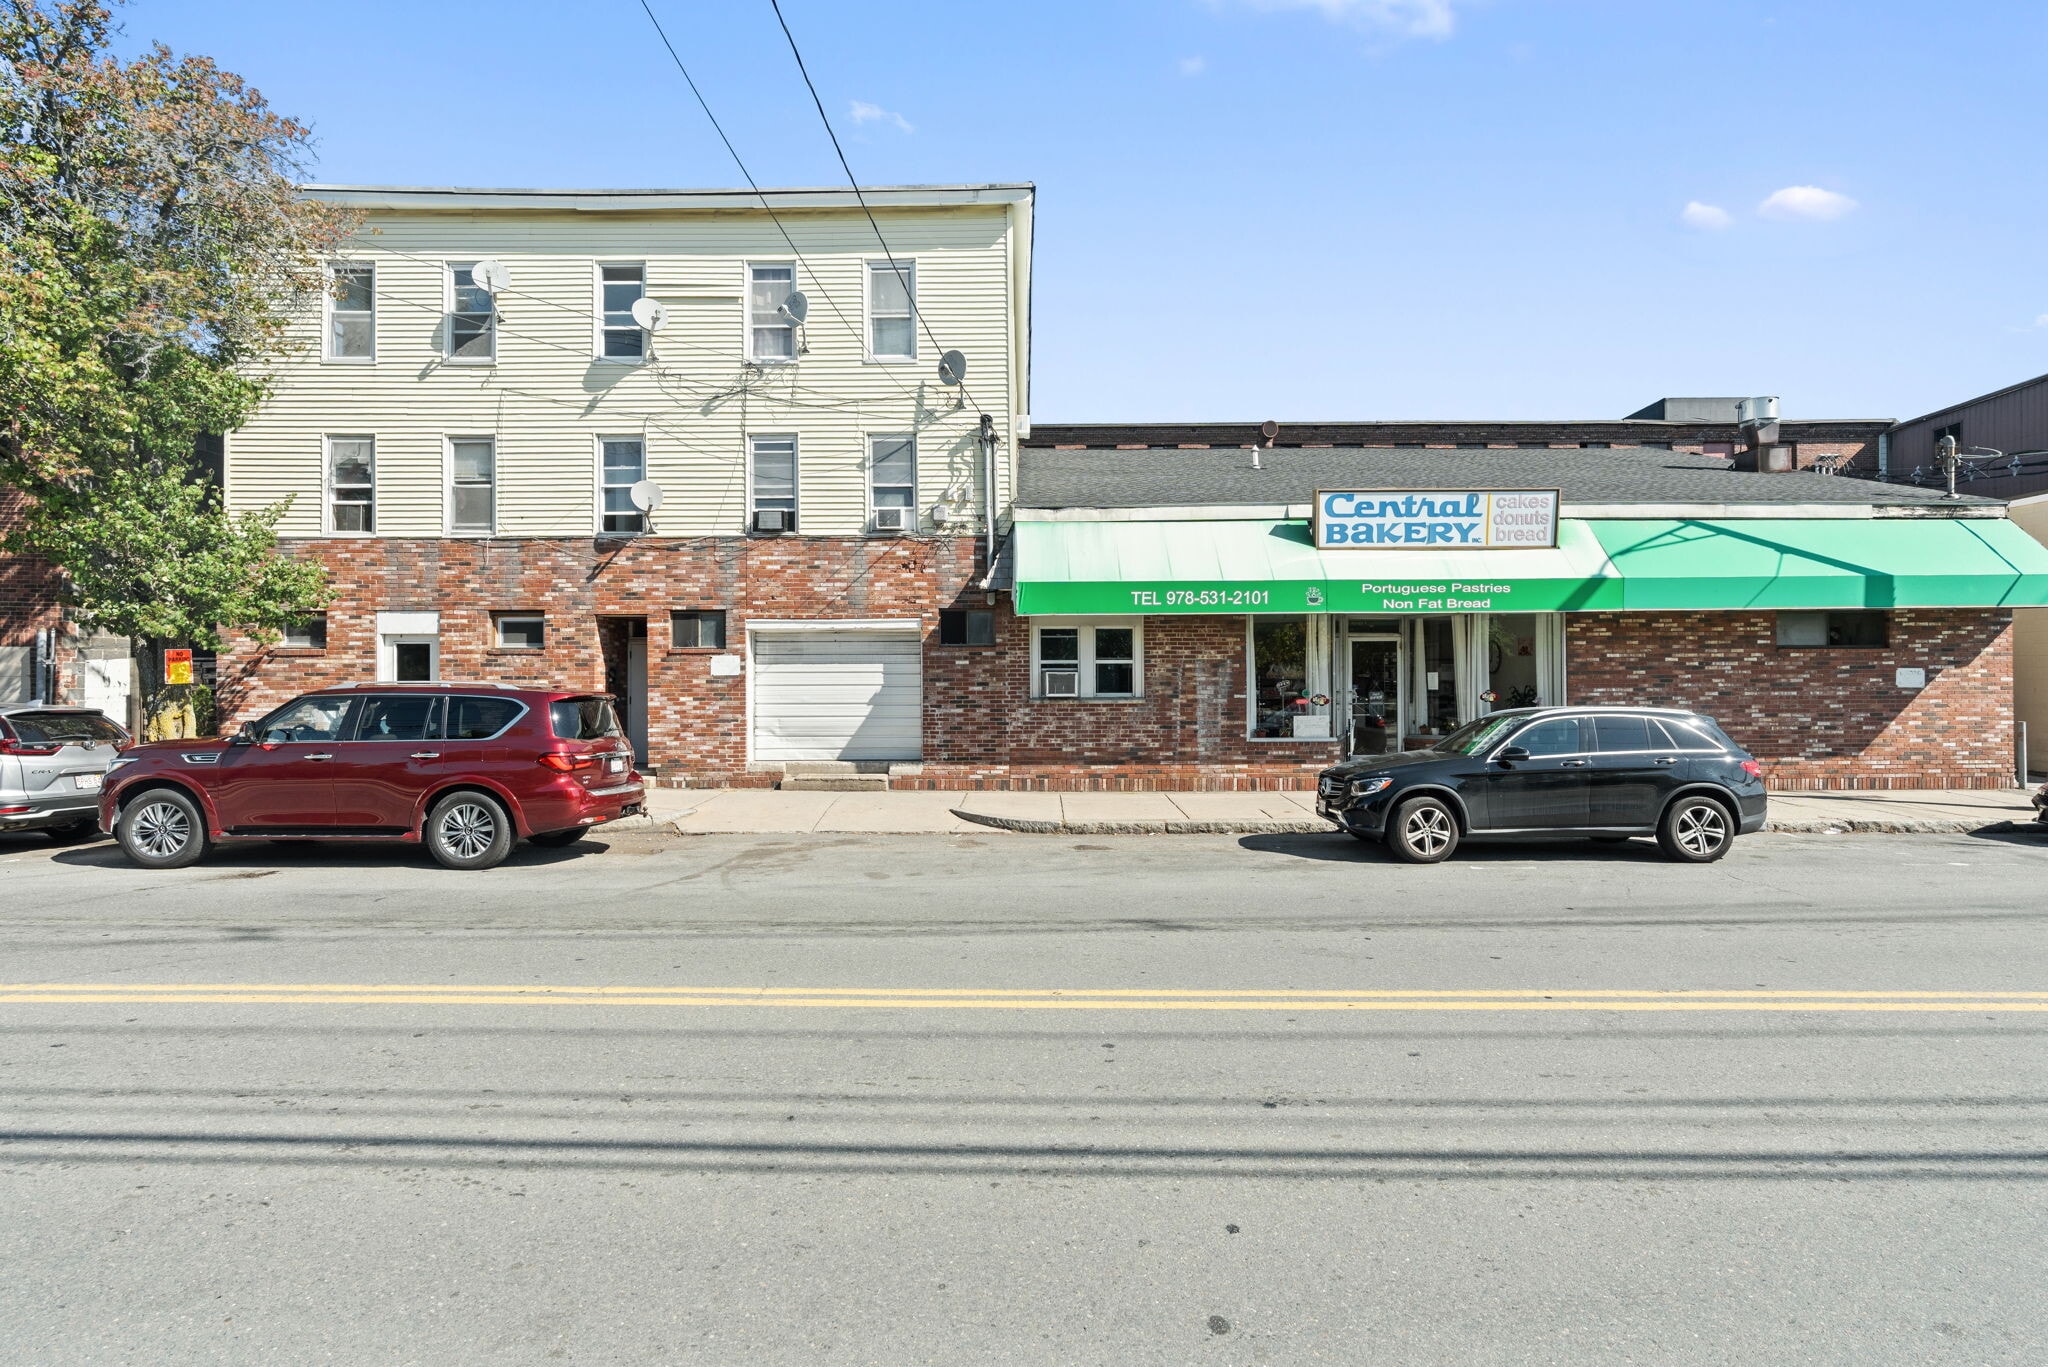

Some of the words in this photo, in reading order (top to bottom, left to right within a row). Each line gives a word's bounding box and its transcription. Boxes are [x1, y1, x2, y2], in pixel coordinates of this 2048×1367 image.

[1325, 493, 1483, 518] Central
[1496, 494, 1550, 509] cakes
[1493, 510, 1550, 526] donuts
[1495, 526, 1548, 541] bread
[1362, 583, 1447, 595] Portuguese
[1451, 583, 1511, 593] Pastries
[1131, 591, 1161, 606] TEL
[1166, 590, 1269, 605] 978-531-2101
[1383, 599, 1413, 609] Non
[1418, 598, 1443, 609] Fat
[1447, 598, 1491, 608] Bread
